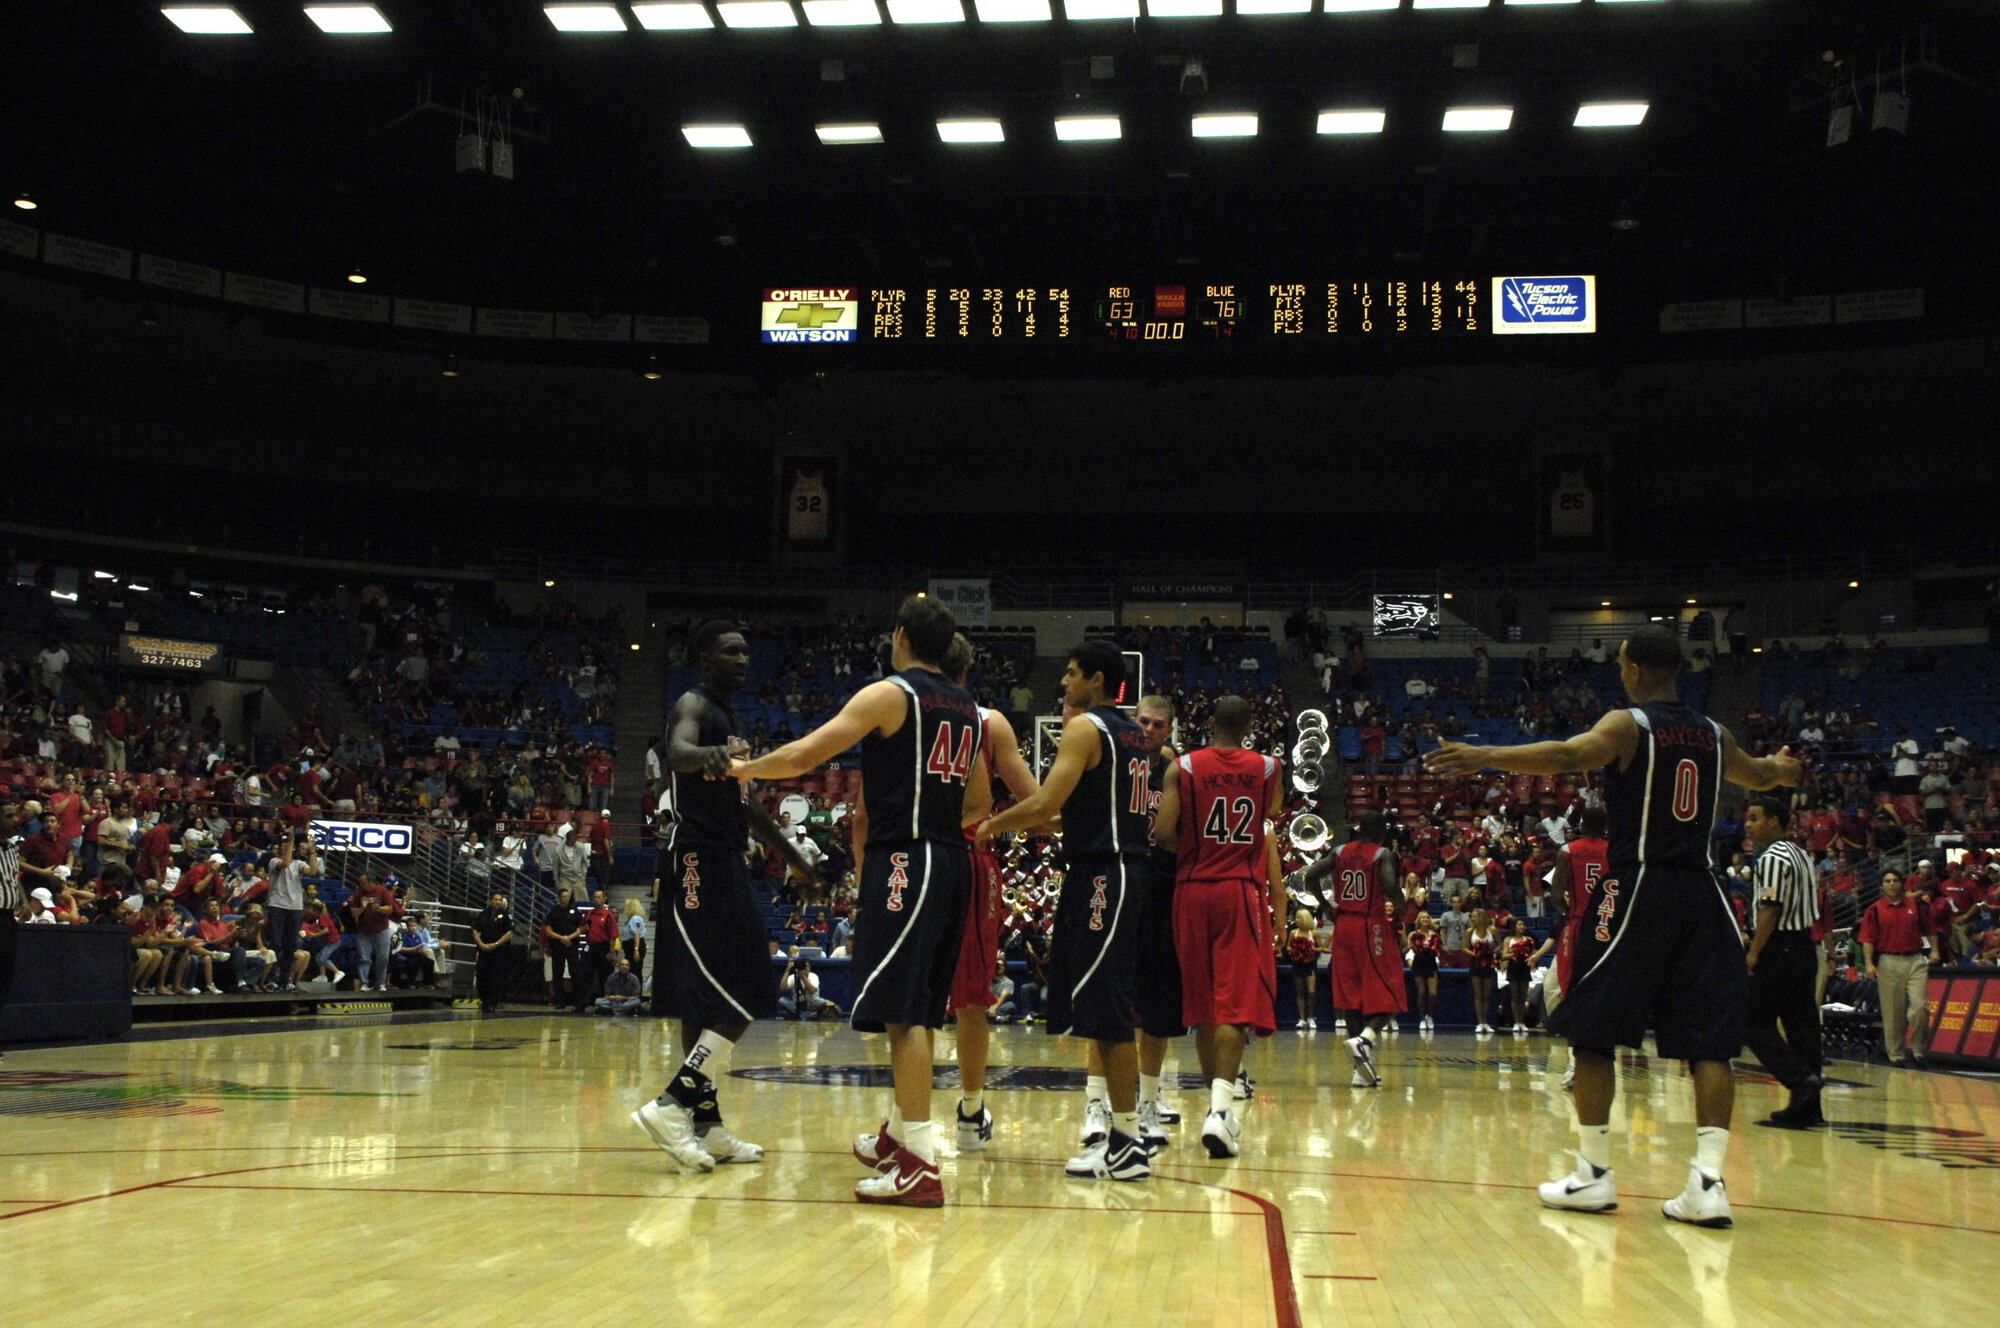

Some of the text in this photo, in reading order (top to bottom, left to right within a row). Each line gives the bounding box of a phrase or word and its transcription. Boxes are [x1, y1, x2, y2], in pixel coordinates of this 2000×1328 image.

[770, 289, 850, 302] O'RIELLY
[871, 288, 1070, 302] PLYR 5 20 33 42 54
[1108, 287, 1130, 298] RED
[1206, 285, 1235, 297] BLUE
[1269, 284, 1306, 297] PLYR
[1327, 283, 1338, 296] 2
[1387, 281, 1407, 294] 12
[1422, 281, 1442, 294] 14
[1455, 280, 1477, 293] 44
[1521, 282, 1569, 294] Tucson
[1275, 296, 1301, 309] PTS
[1361, 294, 1373, 308] 0
[1422, 293, 1442, 306] 13
[1466, 293, 1477, 306] 9
[1527, 292, 1578, 305] Electric
[876, 301, 902, 314] PTS
[926, 300, 936, 313] 6
[959, 300, 970, 313] 5
[1017, 300, 1032, 313] 11
[1059, 300, 1070, 313] 5
[1110, 302, 1134, 319] 63
[1213, 300, 1236, 318] 76
[1273, 305, 1473, 322] RBS 0 1 4 9 11
[1531, 304, 1579, 316] Power
[874, 312, 1069, 326] RBS 2 2 0 4 4
[1273, 318, 1477, 334] FLS 2 0 3 3 2
[769, 330, 850, 342] WATSON
[925, 325, 936, 338] 2
[958, 325, 969, 337] 4
[991, 325, 1002, 337] 0
[1025, 325, 1036, 337] 5
[1058, 325, 1069, 337] 3
[1144, 322, 1185, 340] 00.0
[796, 495, 822, 513] 32
[1559, 492, 1585, 511] 25
[1131, 584, 1233, 593] HALL OF CHAMPIONS
[141, 654, 202, 669] 327-7463
[447, 751, 456, 760] 19
[926, 720, 973, 787] 44
[829, 762, 840, 770] 20
[1128, 757, 1149, 816] 11
[1201, 773, 1257, 791] HORNE
[1672, 758, 1699, 822] 0
[495, 822, 505, 832] 19
[1203, 796, 1255, 845] 42
[682, 852, 700, 910] CATS
[886, 852, 909, 912] CATS
[1341, 869, 1367, 901] 20
[1585, 863, 1602, 894] 5
[1089, 875, 1108, 931] CATS
[1594, 879, 1620, 942] CATS
